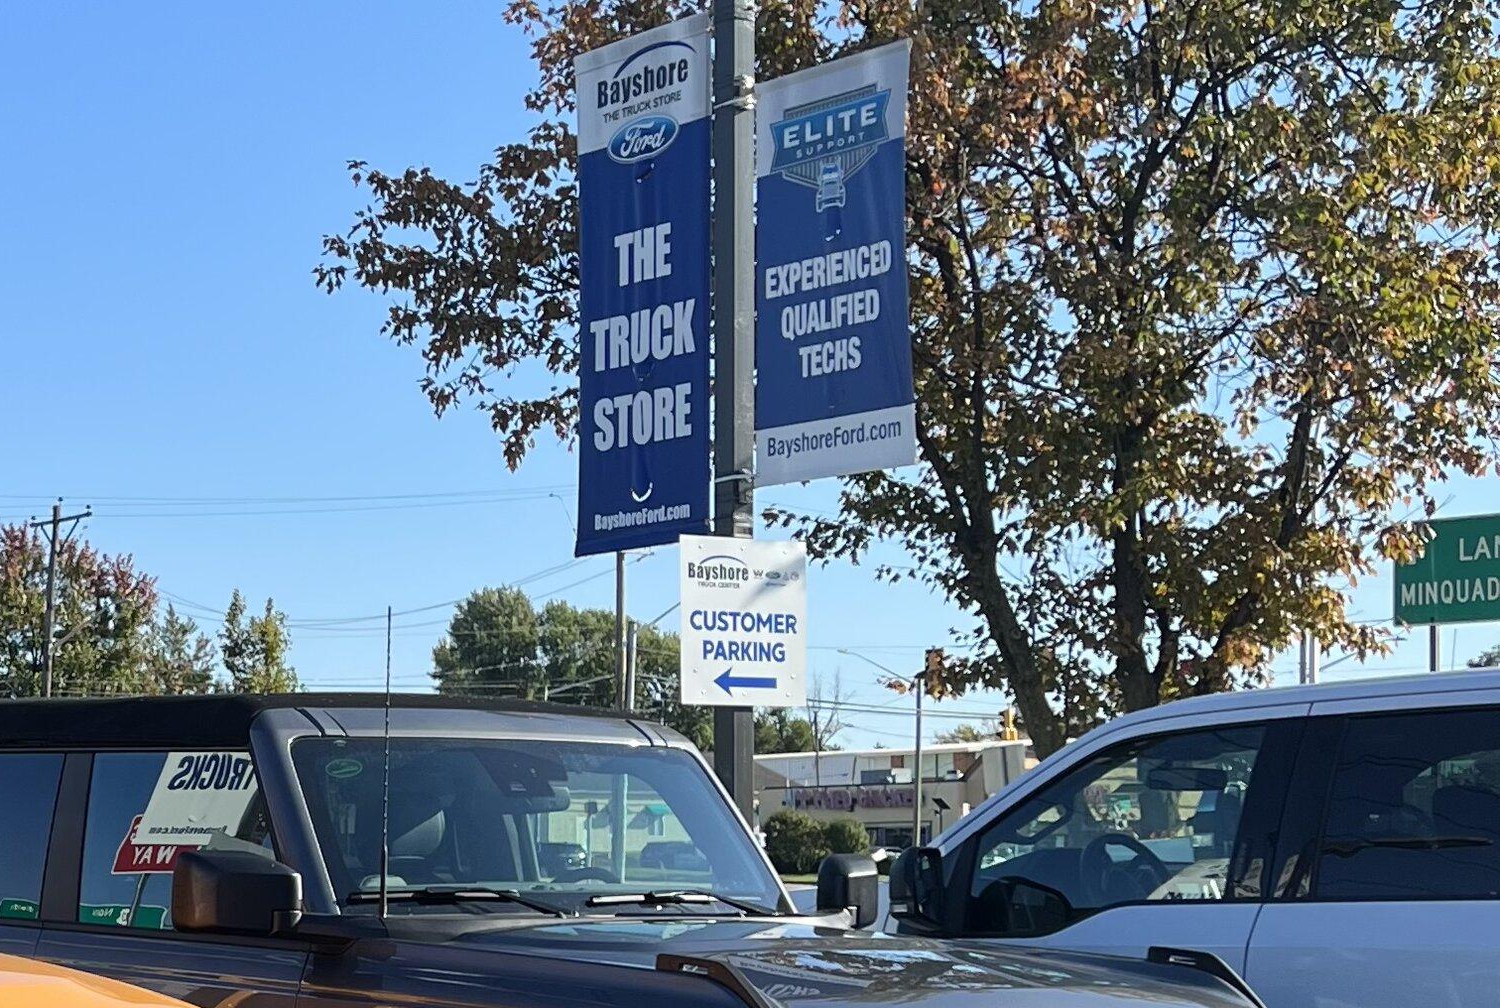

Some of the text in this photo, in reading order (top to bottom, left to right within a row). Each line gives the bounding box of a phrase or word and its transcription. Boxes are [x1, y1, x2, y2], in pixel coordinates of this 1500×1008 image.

[597, 58, 689, 109] Bayshore
[603, 90, 682, 123] THE TRUCK STORE
[783, 102, 877, 149] ELITE
[620, 121, 666, 157] Ford
[796, 132, 865, 158] SUPPORT
[614, 222, 672, 287] THE
[765, 240, 892, 300] EXPERIENCED
[781, 288, 880, 341] QUALIFIED
[590, 298, 696, 372] TRUCK
[799, 336, 862, 378] TECHS
[593, 382, 693, 452] STORE
[767, 420, 902, 459] BayshoreFord.com
[594, 503, 691, 531] BayshoreFord.com
[688, 561, 749, 581] Bayshore
[1401, 577, 1500, 607] MINQUAD
[689, 610, 798, 634] CUSTOMER
[702, 640, 786, 663] PARKING
